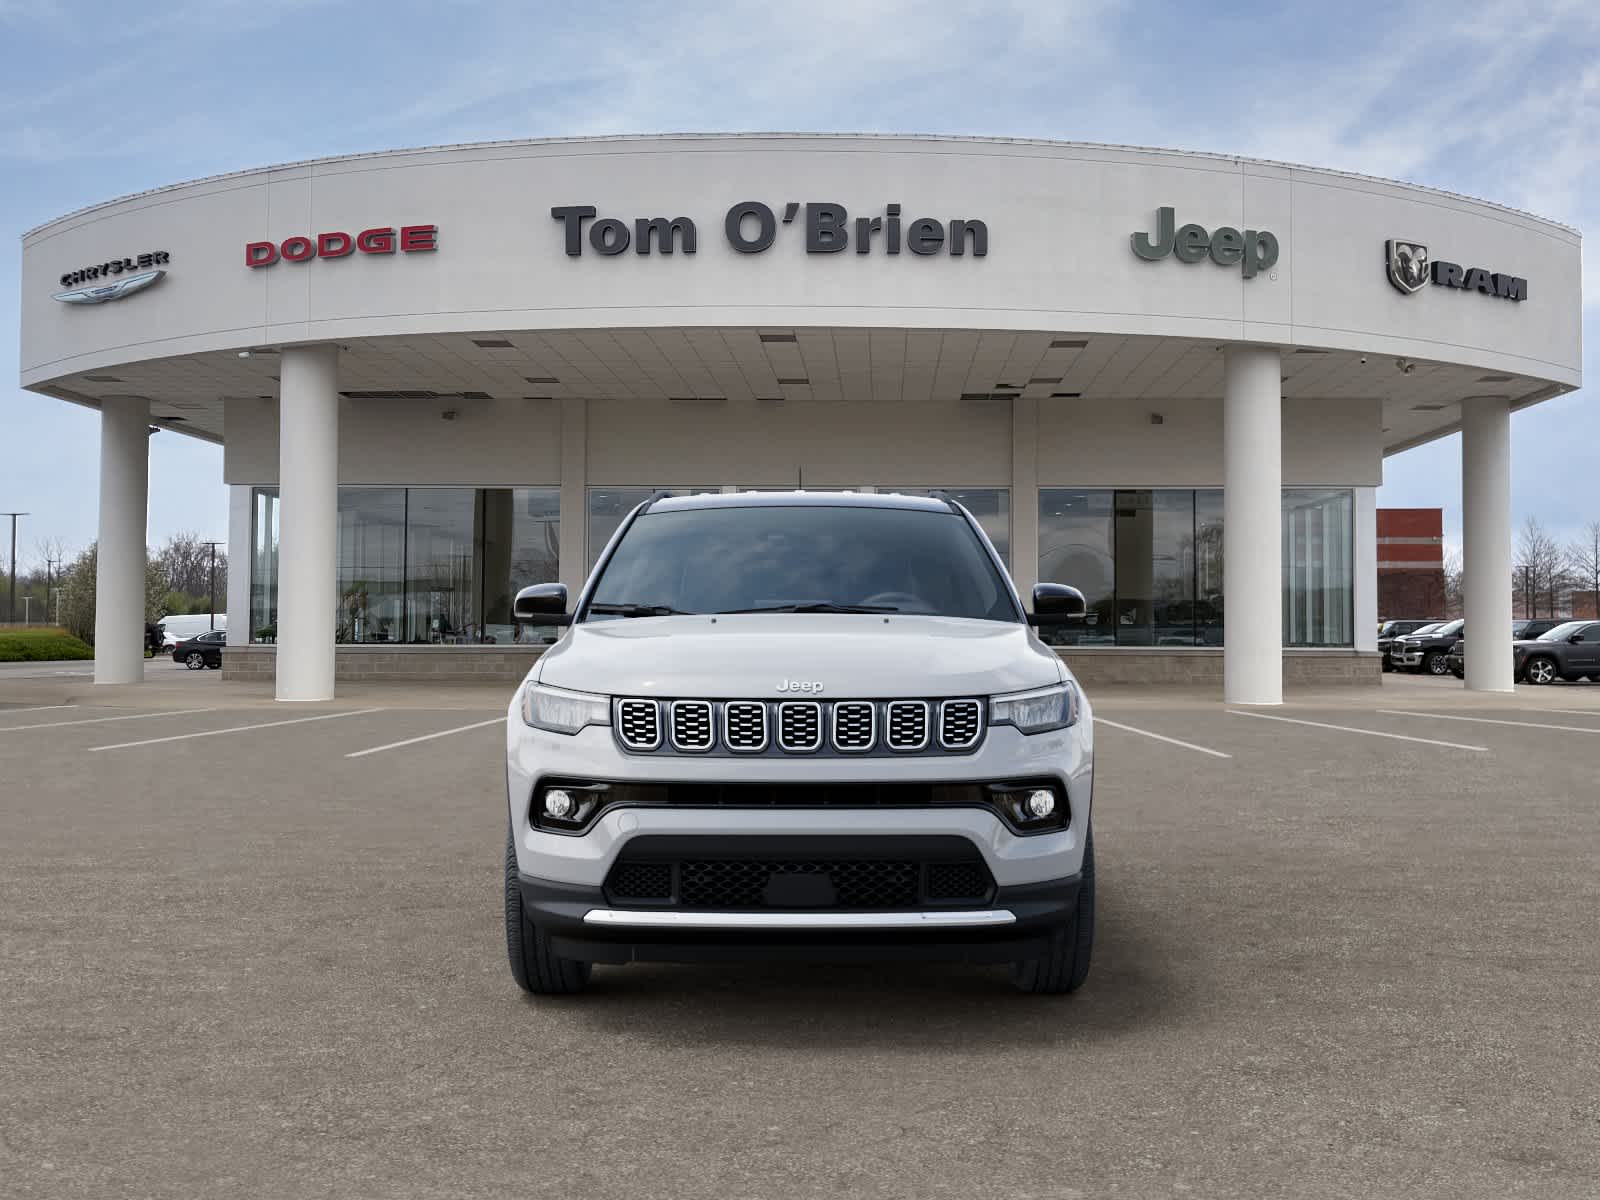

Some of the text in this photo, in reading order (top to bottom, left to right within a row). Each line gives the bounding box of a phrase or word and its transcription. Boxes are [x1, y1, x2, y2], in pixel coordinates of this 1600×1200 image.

[245, 225, 437, 269] DODGE
[551, 205, 697, 257] Tom
[1130, 207, 1280, 279] Jeep
[60, 250, 170, 287] CHRYSLER
[1430, 261, 1528, 301] RAM
[776, 677, 824, 694] Jeep
